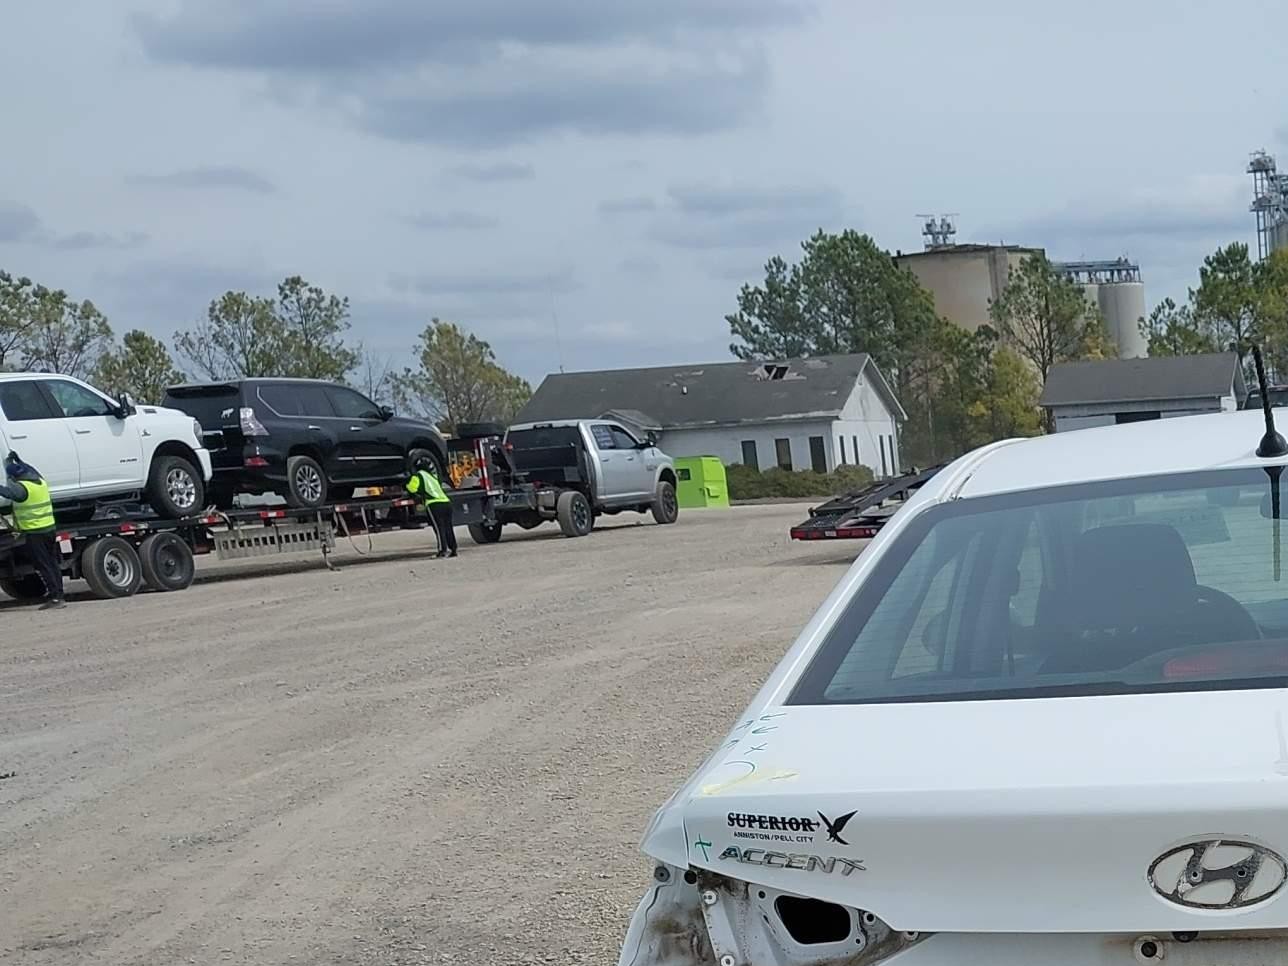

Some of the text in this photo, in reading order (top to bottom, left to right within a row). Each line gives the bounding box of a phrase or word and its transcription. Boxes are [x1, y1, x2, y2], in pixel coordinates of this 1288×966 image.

[727, 812, 816, 832] SUPERIOR
[796, 835, 814, 843] CITY
[718, 845, 867, 877] ACCENT
